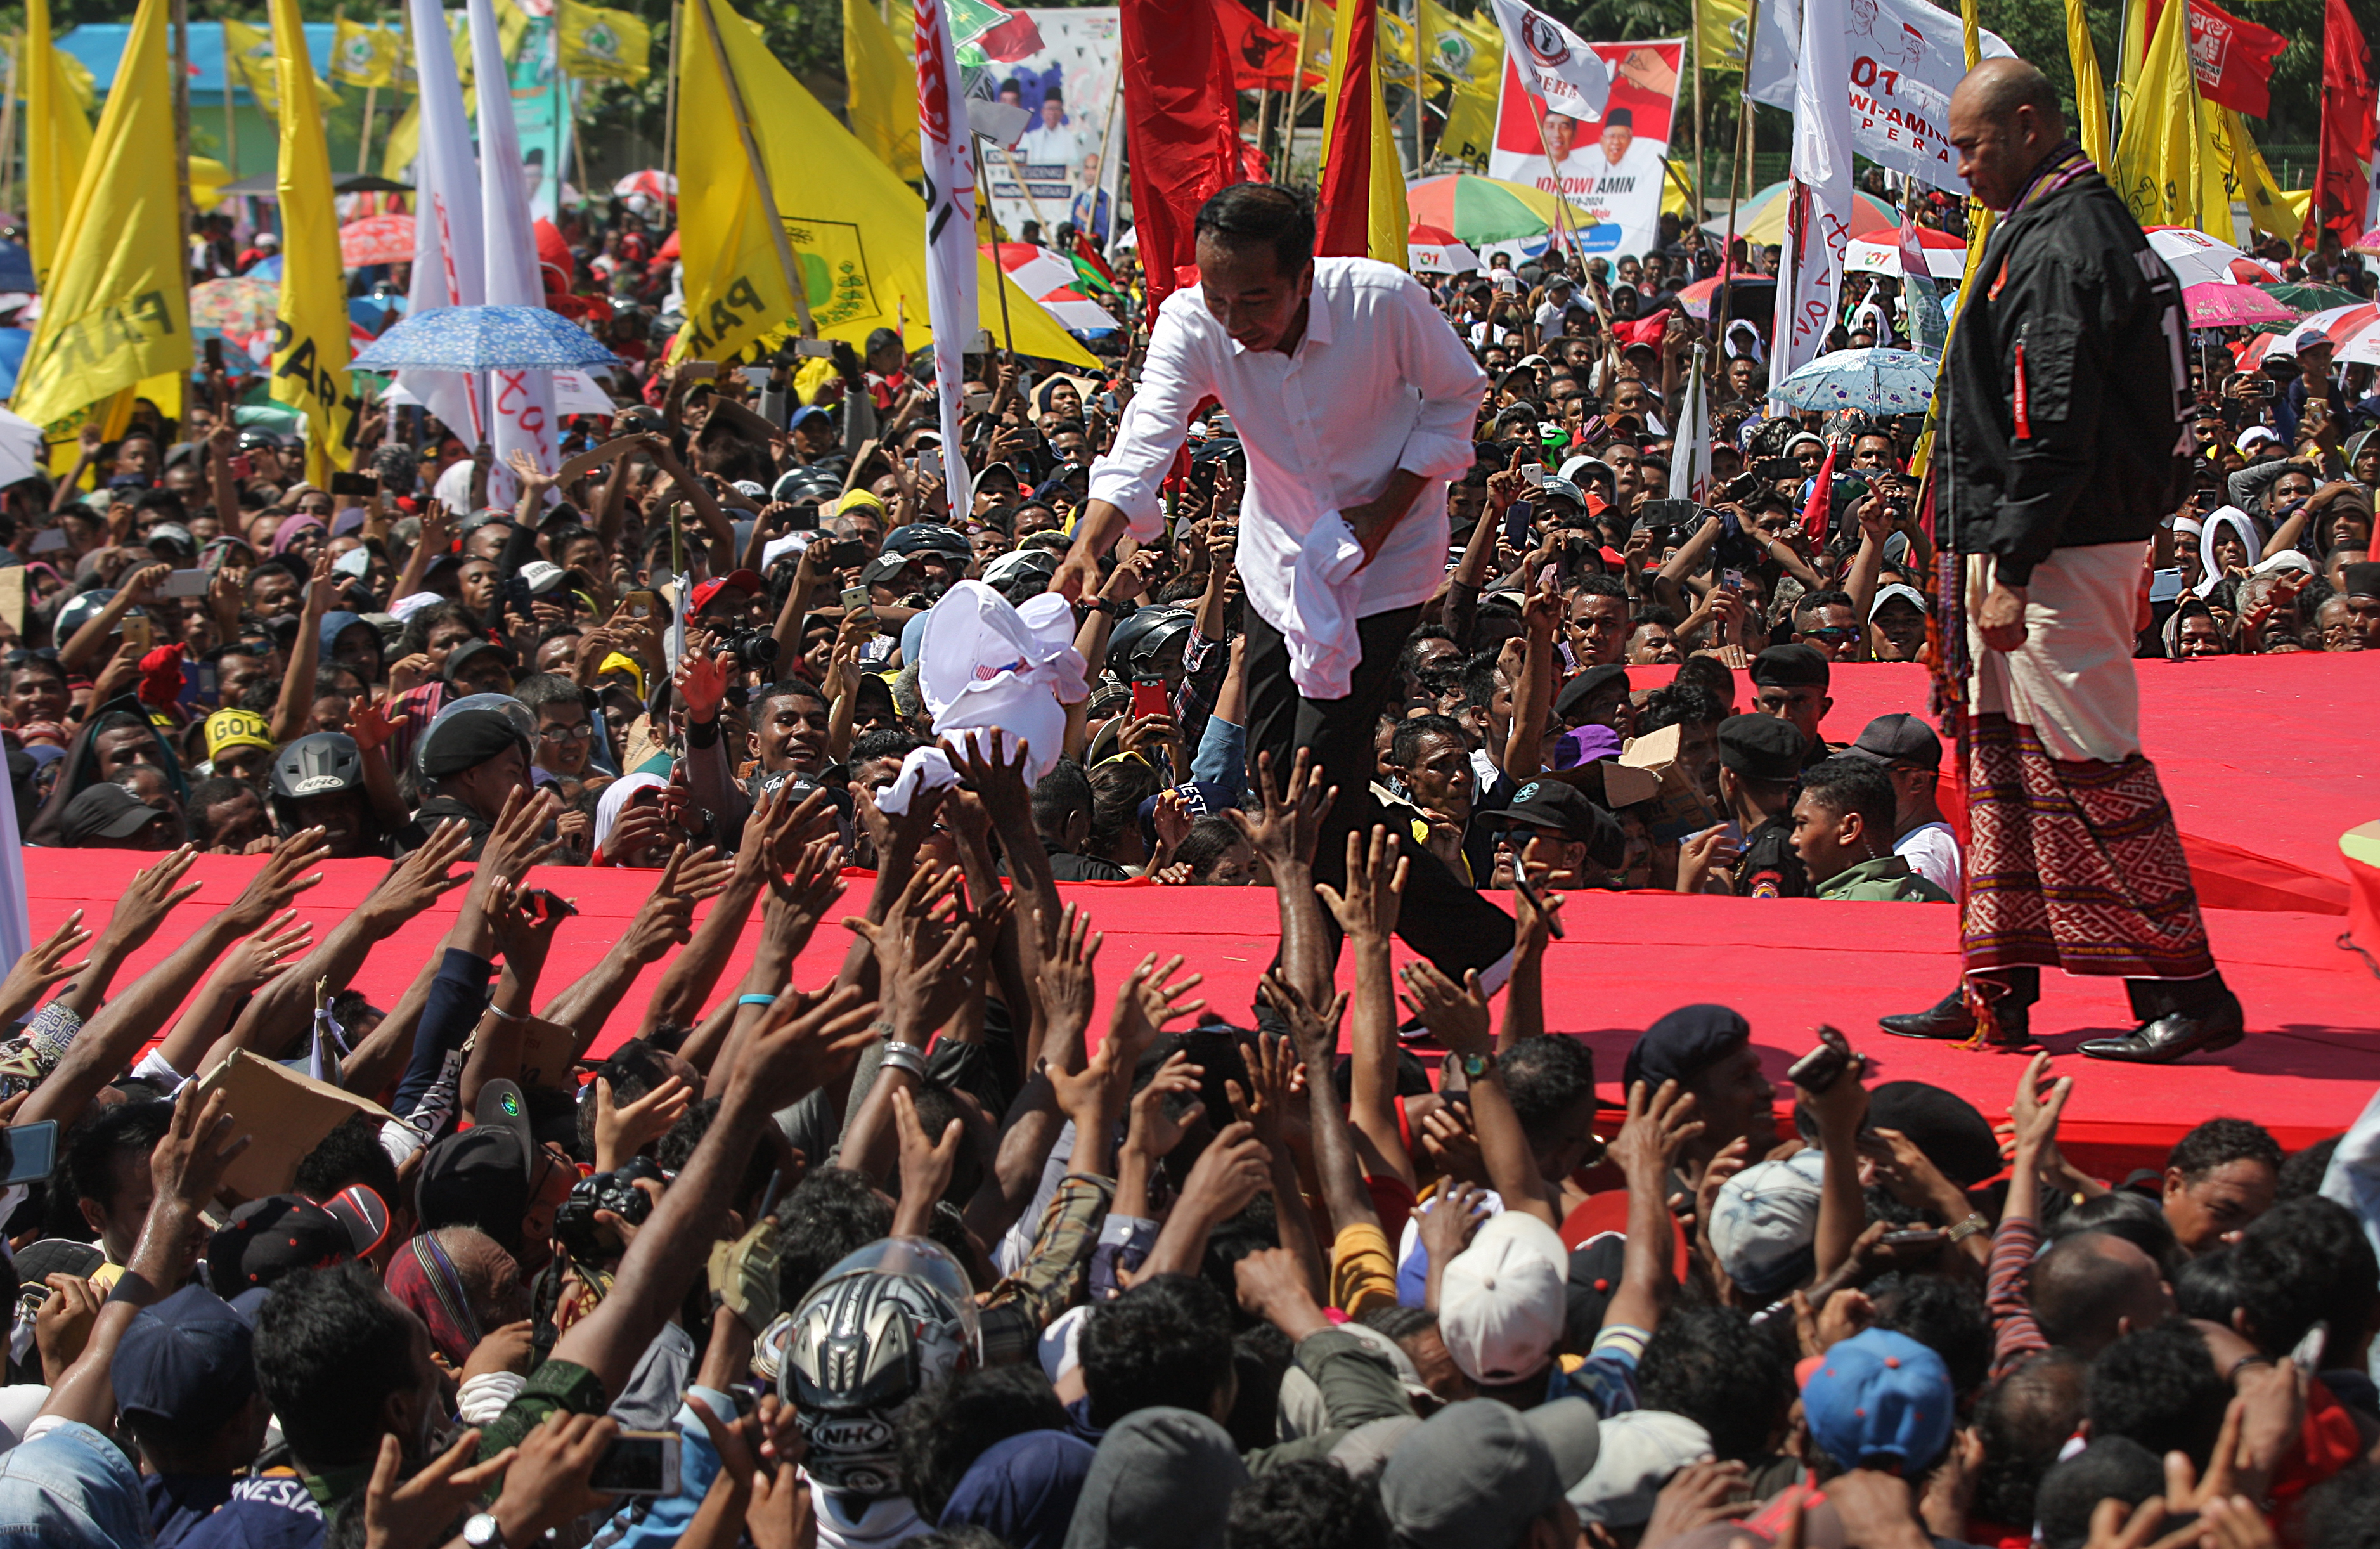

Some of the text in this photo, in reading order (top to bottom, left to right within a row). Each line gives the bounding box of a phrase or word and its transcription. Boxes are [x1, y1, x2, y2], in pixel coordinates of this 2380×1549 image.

[1851, 56, 1899, 96] 01
[1849, 92, 1950, 148] WI-AMIN
[1595, 177, 1636, 194] AMIN
[412, 1059, 460, 1140] ONVERSE
[824, 1427, 881, 1445] NHK
